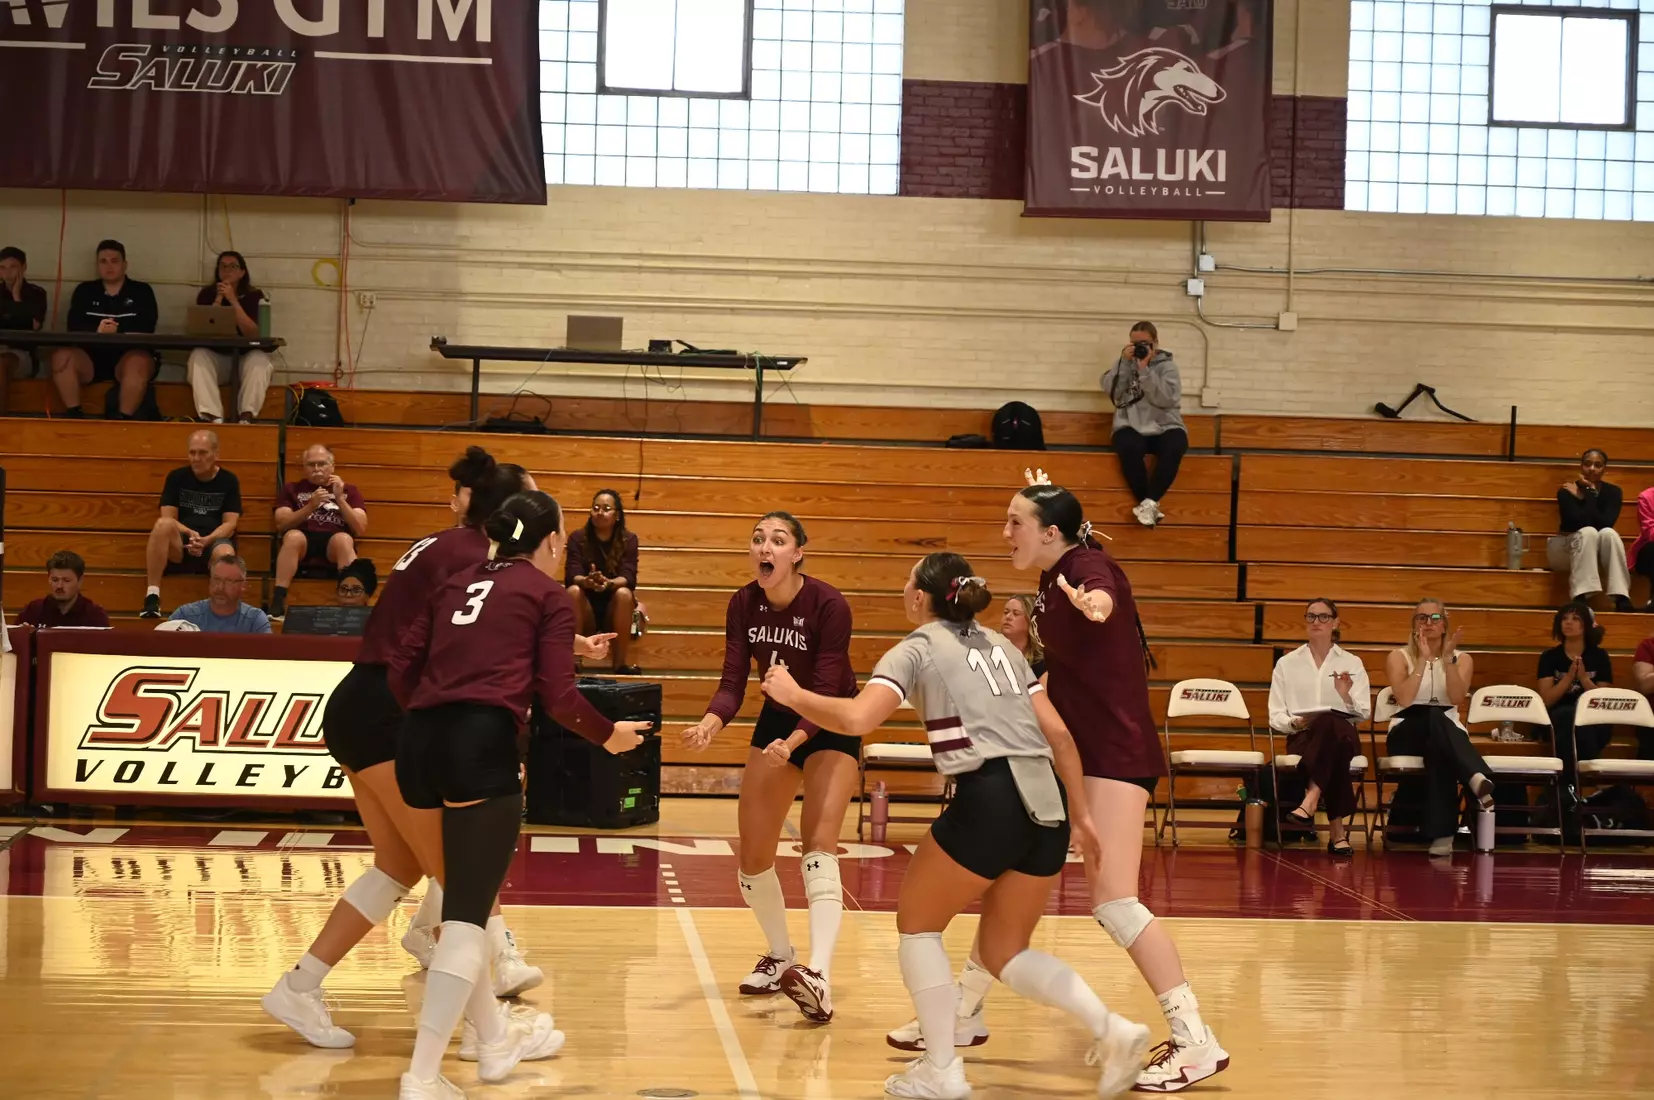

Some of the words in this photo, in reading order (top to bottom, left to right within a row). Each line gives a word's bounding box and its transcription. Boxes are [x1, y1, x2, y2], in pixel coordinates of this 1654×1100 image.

[162, 45, 297, 58] VOLLEYBALL
[87, 43, 297, 95] SALUKI
[1070, 145, 1227, 182] SALUKI
[1093, 185, 1202, 197] VOLLEYBALL
[451, 580, 494, 625] 3
[747, 625, 808, 651] SALUKIS
[966, 645, 1022, 696] 11
[75, 758, 347, 789] VOLLEYB
